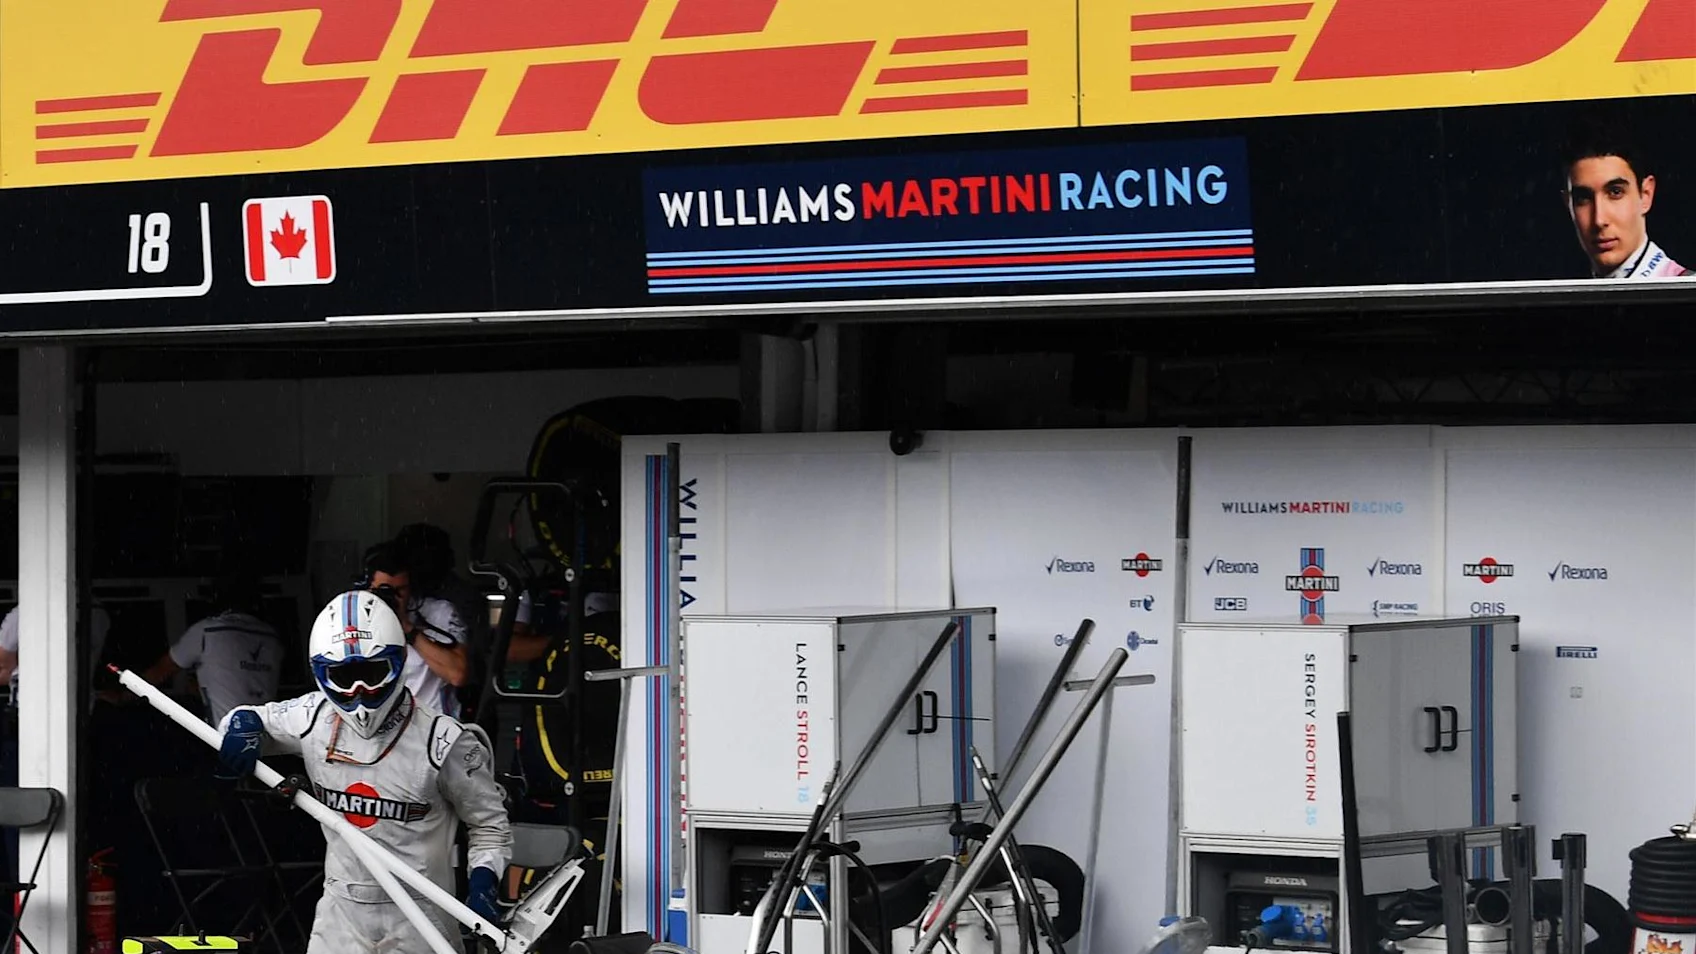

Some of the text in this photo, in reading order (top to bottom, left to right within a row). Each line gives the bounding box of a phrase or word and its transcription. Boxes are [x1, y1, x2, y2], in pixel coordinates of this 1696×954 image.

[659, 165, 1228, 228] WILLIAMS MARTINI RACING
[127, 212, 171, 273] 18
[1221, 501, 1404, 514] WILLIAMS MARTINI RACING
[678, 469, 698, 608] WILLIA
[1056, 559, 1095, 573] Rexona
[1122, 559, 1162, 571] MARTINI
[1216, 559, 1259, 575] Rexona
[1380, 560, 1422, 576] Rexona
[1464, 564, 1513, 577] MARTINI
[1561, 564, 1608, 580] Rexona
[1286, 576, 1339, 591] MARTINI
[1215, 598, 1247, 611] JCB
[1470, 601, 1506, 614] ORIS
[1556, 646, 1598, 659] PIRELLI
[796, 643, 808, 705] LANCE
[1304, 653, 1316, 718] SERGEY
[797, 710, 809, 780] STROLL
[1305, 724, 1317, 801] SIROTKIN
[326, 789, 407, 819] MARTINI
[1263, 876, 1307, 887] HONDA
